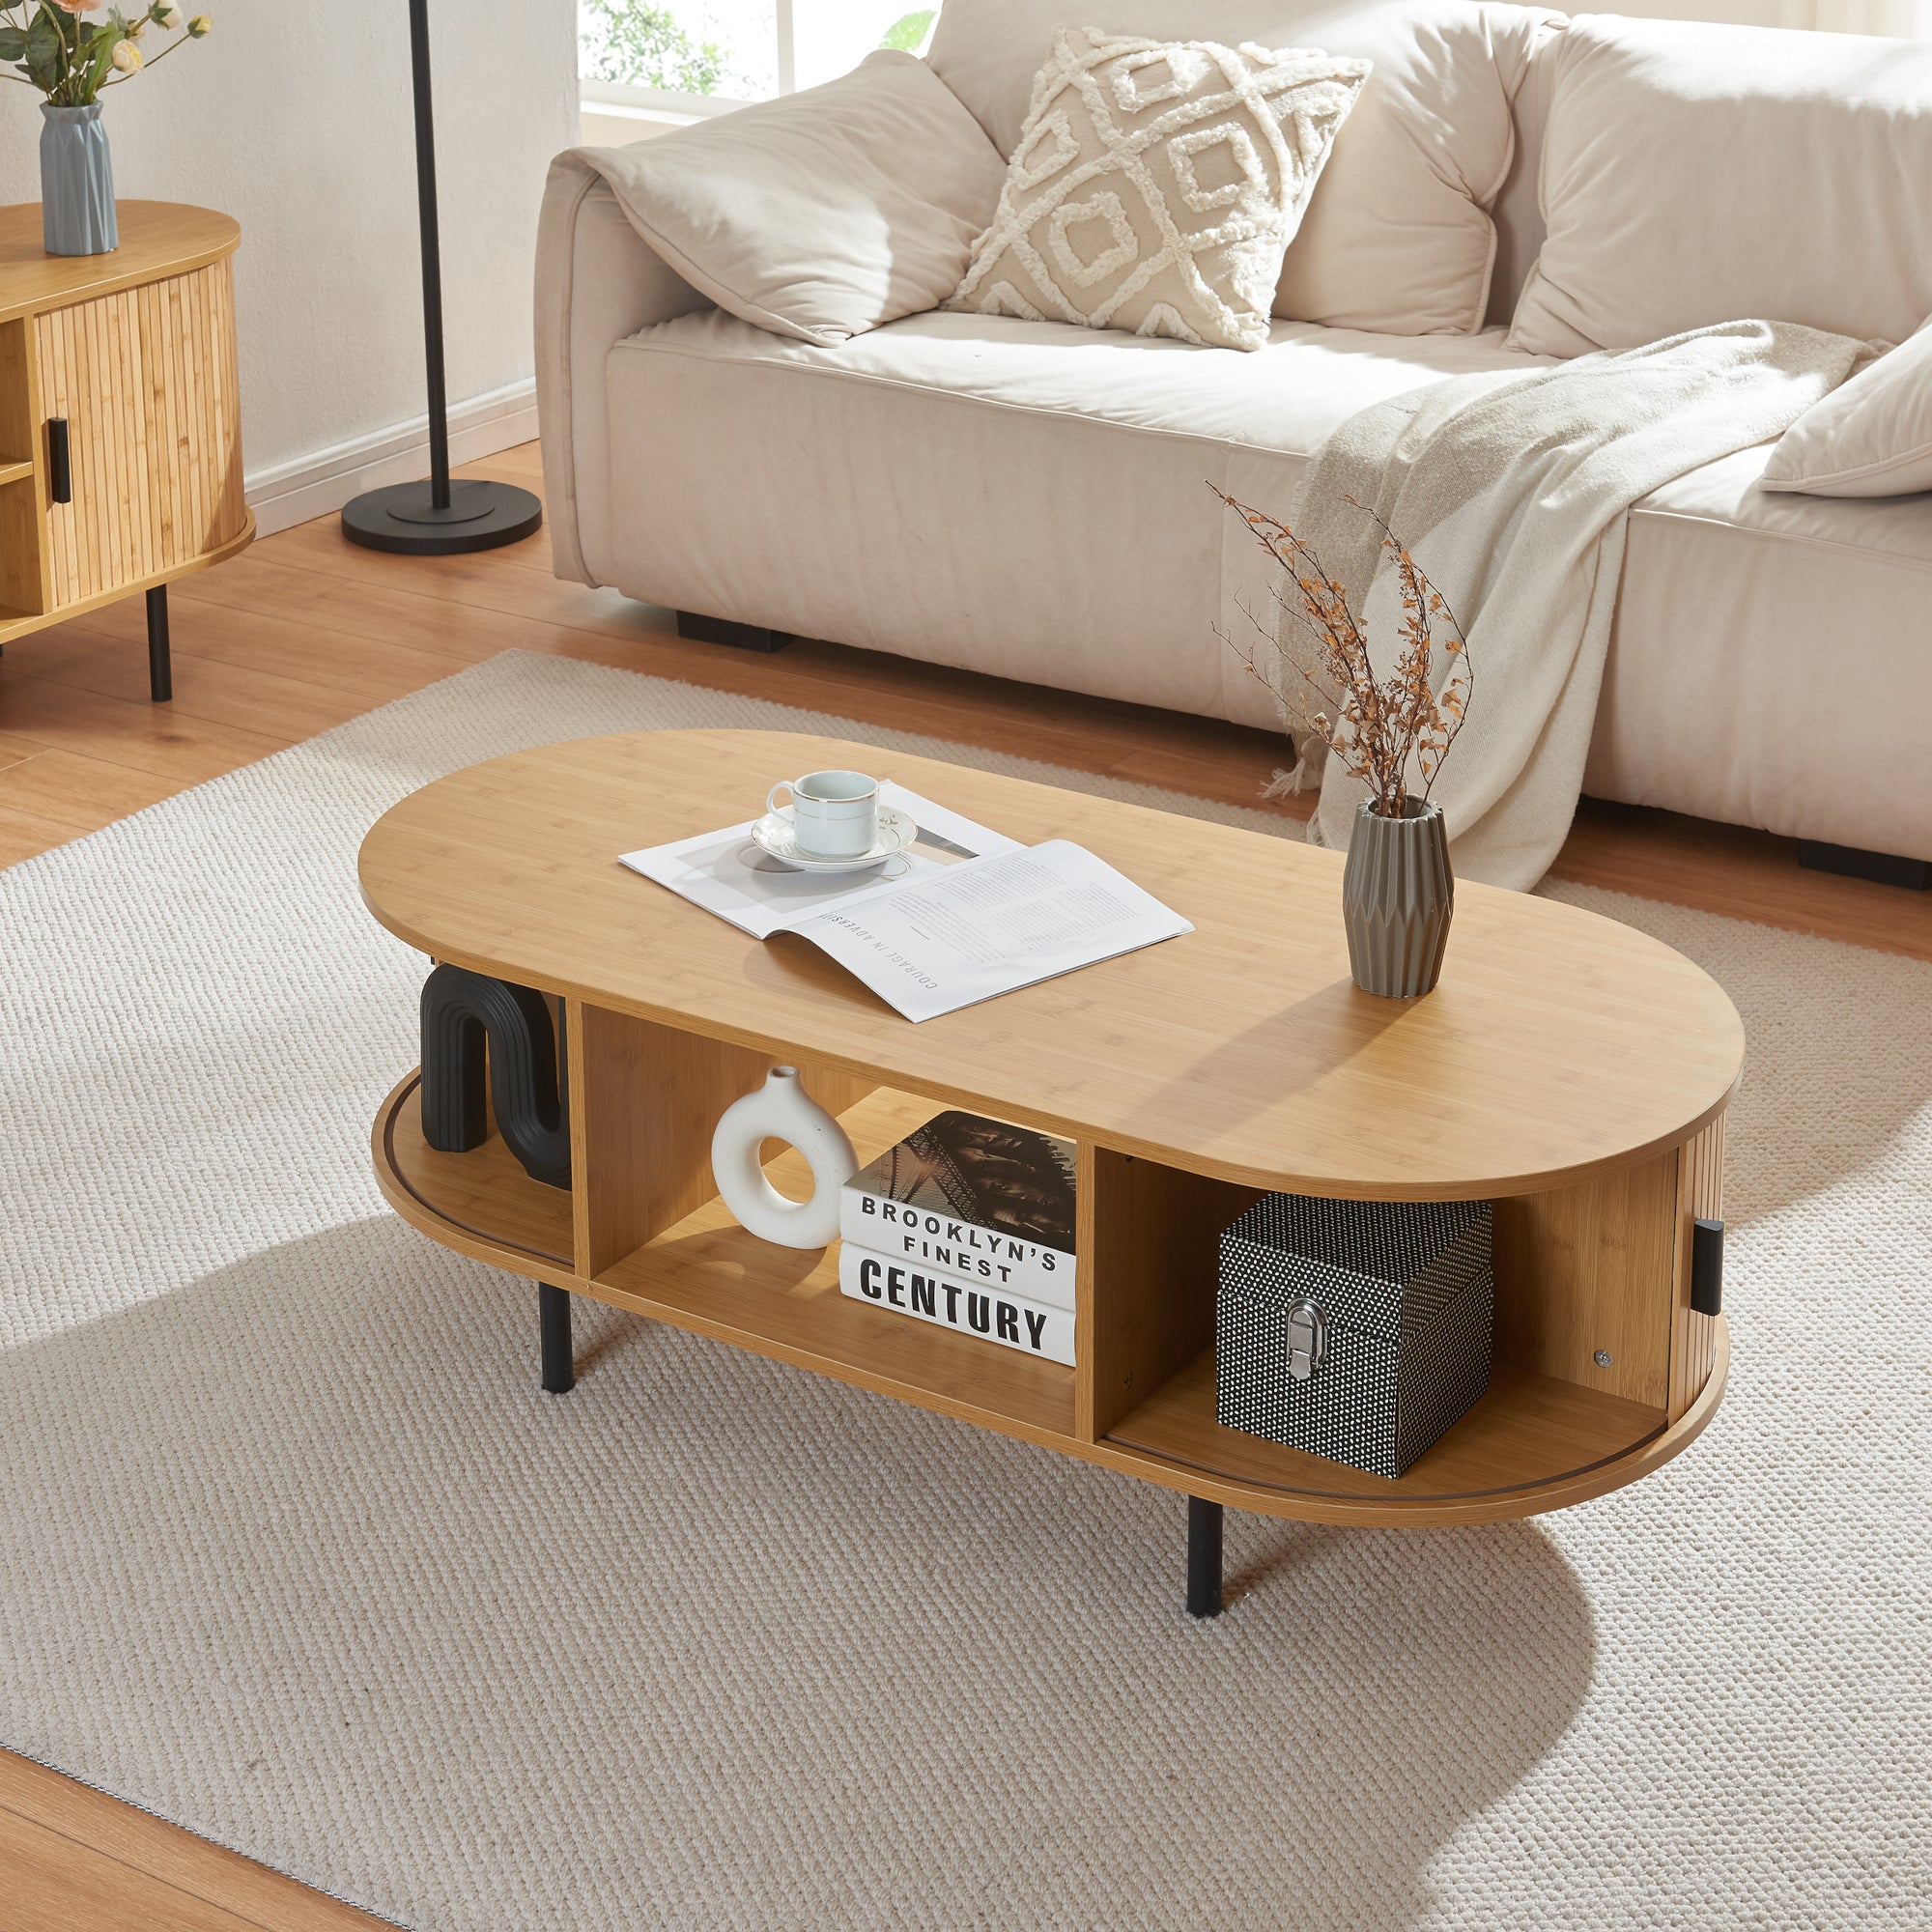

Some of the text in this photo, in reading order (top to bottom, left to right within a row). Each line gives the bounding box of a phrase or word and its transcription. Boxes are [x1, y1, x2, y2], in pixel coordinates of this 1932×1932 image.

[872, 941, 888, 952] IN
[885, 952, 938, 989] COURAGE
[862, 1196, 1057, 1271] BROOKLYN'S
[903, 1236, 1011, 1282] FINEST
[860, 1259, 1047, 1350] CENTURY
